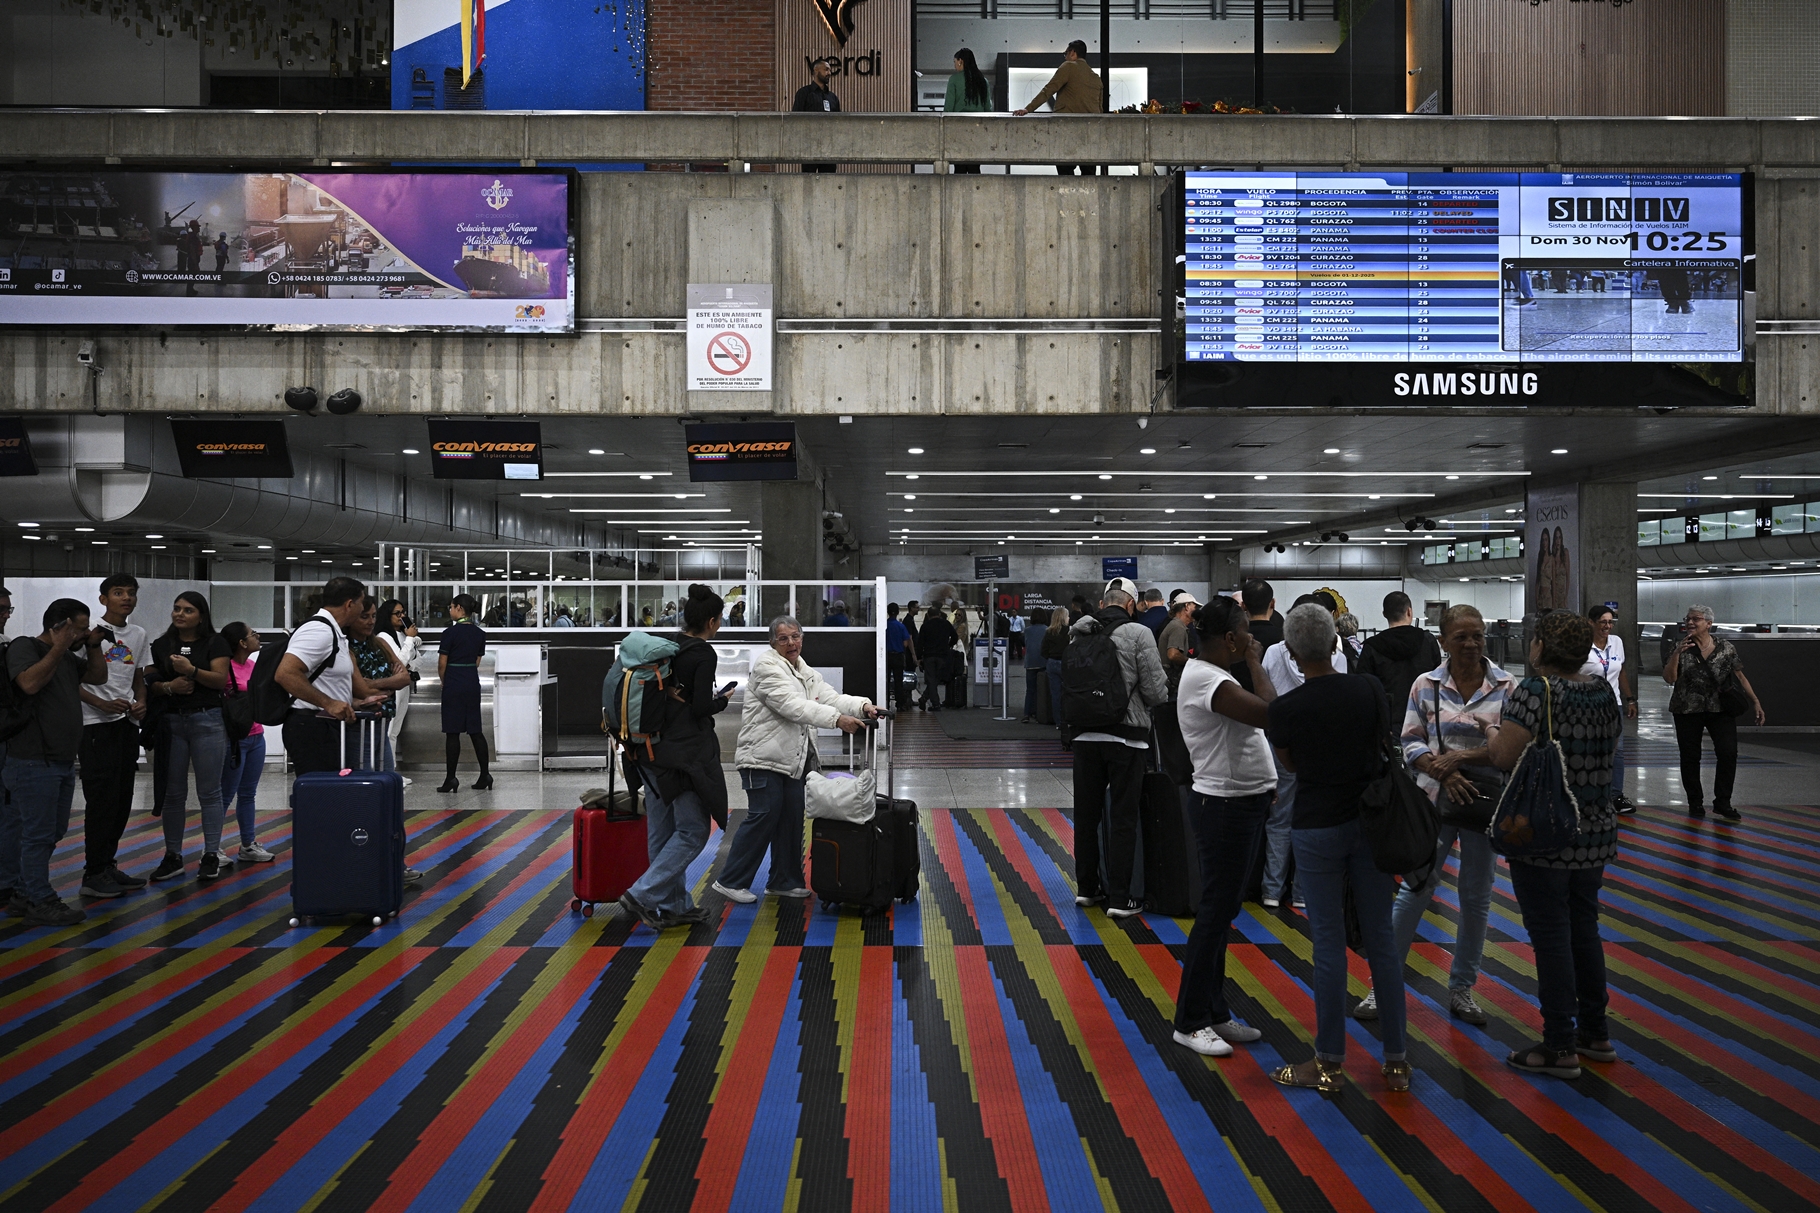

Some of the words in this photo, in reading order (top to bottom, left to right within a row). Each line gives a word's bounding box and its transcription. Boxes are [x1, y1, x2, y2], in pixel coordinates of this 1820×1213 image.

[1552, 200, 1687, 220] SINIV
[456, 222, 490, 233] Soluciones
[506, 222, 537, 234] Navegan
[464, 236, 481, 245] Más
[502, 236, 513, 245] del
[516, 236, 532, 245] Mar
[1531, 236, 1568, 245] Dom
[1573, 236, 1592, 245] 30
[1597, 236, 1628, 245] Nov
[1623, 231, 1727, 251] 10:25
[1549, 353, 1588, 361] airport
[1394, 372, 1538, 395] SAMSUNG
[433, 440, 536, 452] conviasa
[687, 442, 792, 452] conviasa
